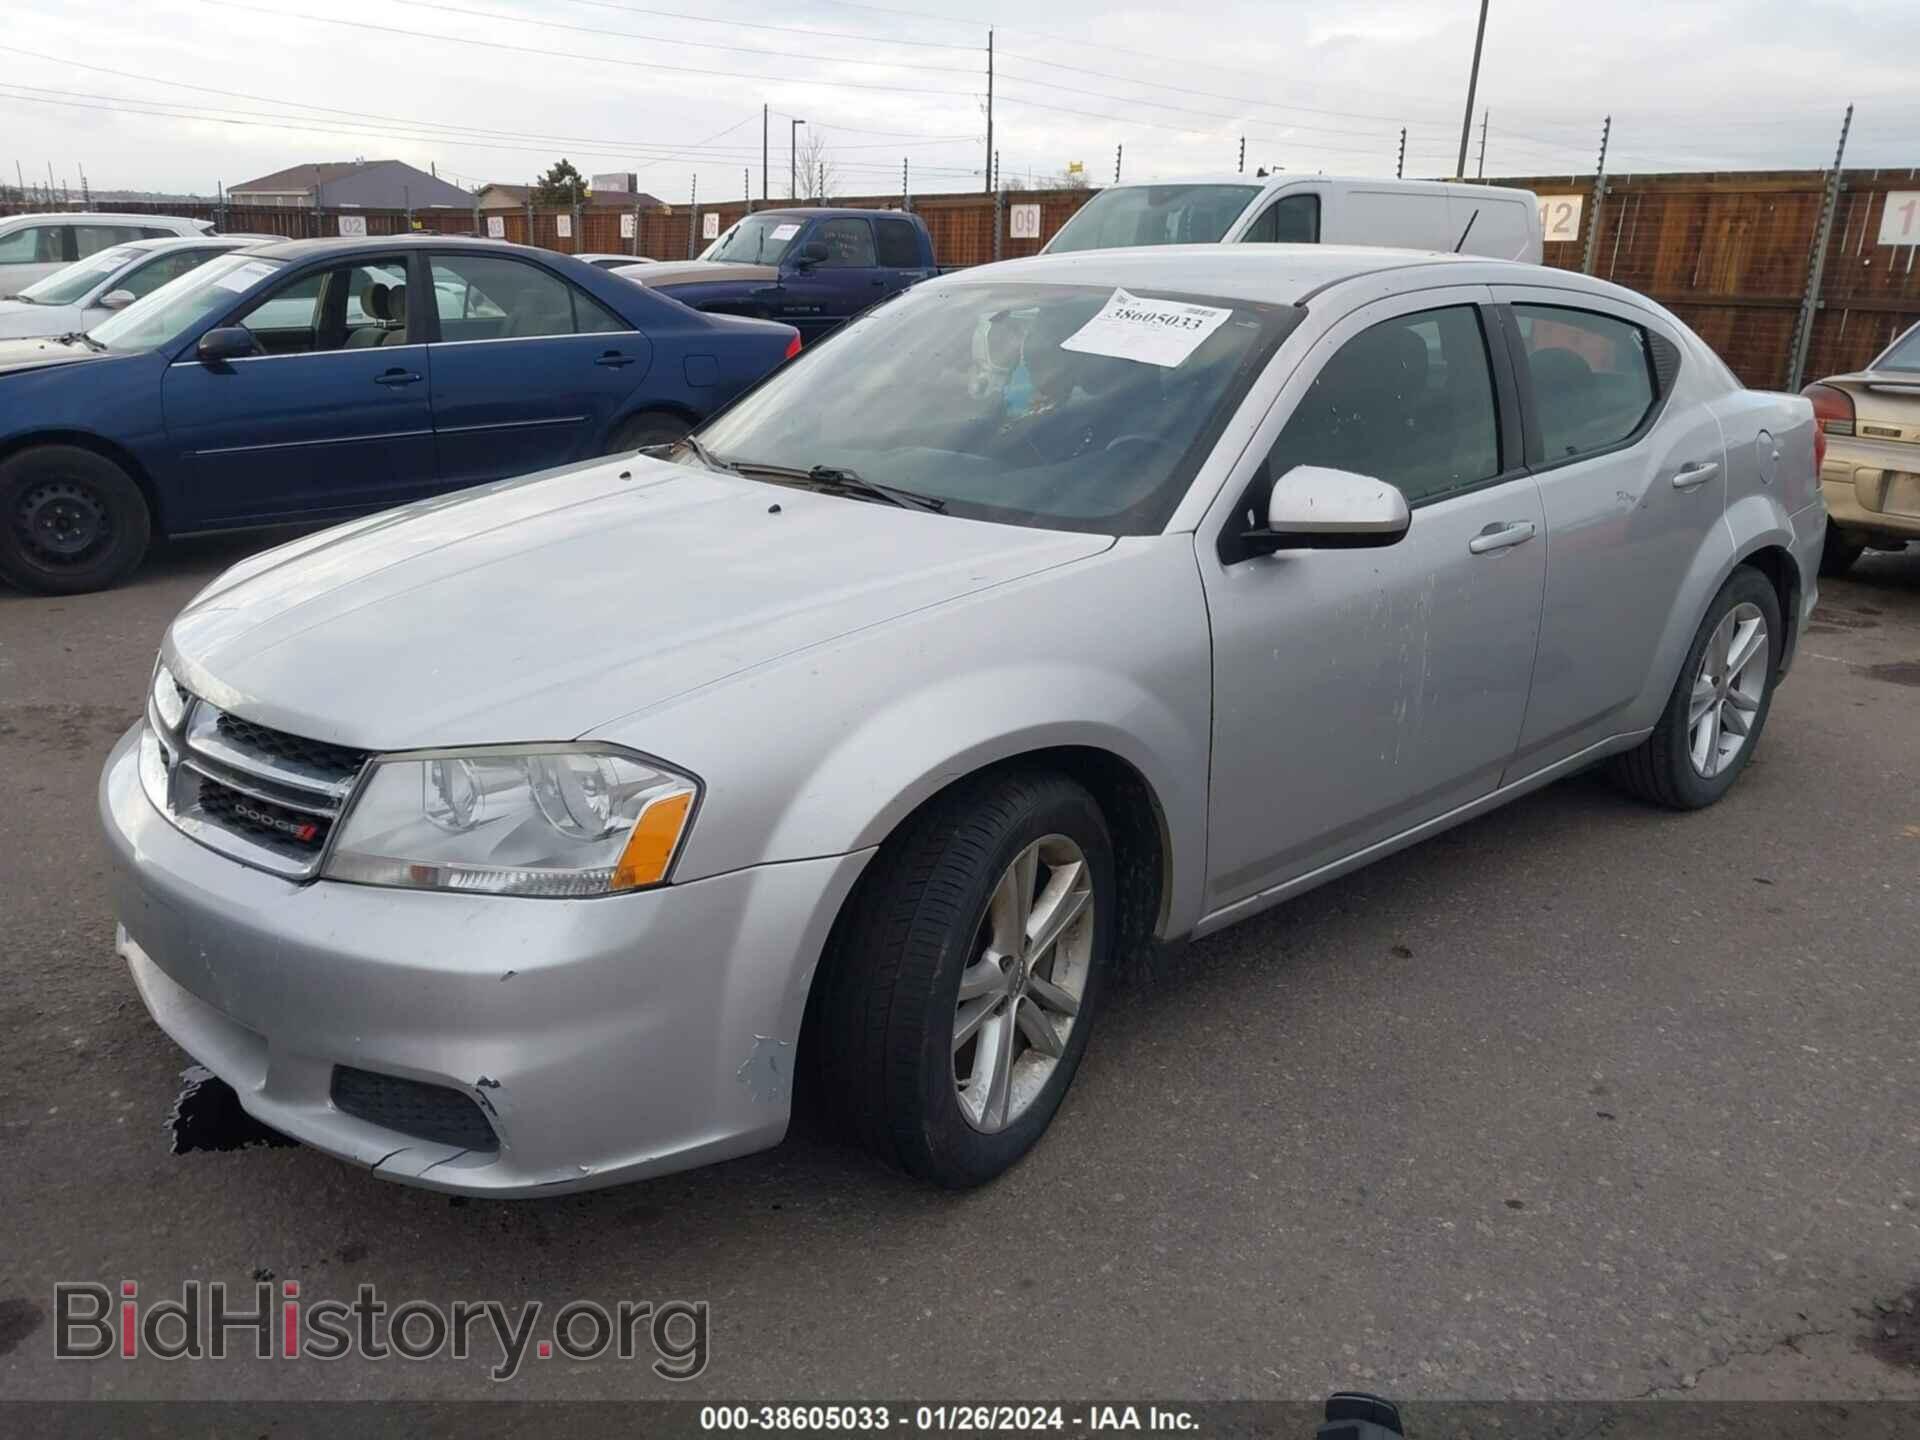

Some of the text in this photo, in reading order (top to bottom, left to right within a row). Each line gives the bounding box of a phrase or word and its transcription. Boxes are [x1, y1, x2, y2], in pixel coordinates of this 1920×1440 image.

[343, 218, 362, 233] 02
[1016, 210, 1035, 232] 09
[1539, 202, 1572, 232] 12
[1109, 307, 1203, 331] 38605033
[235, 803, 304, 834] DODGE
